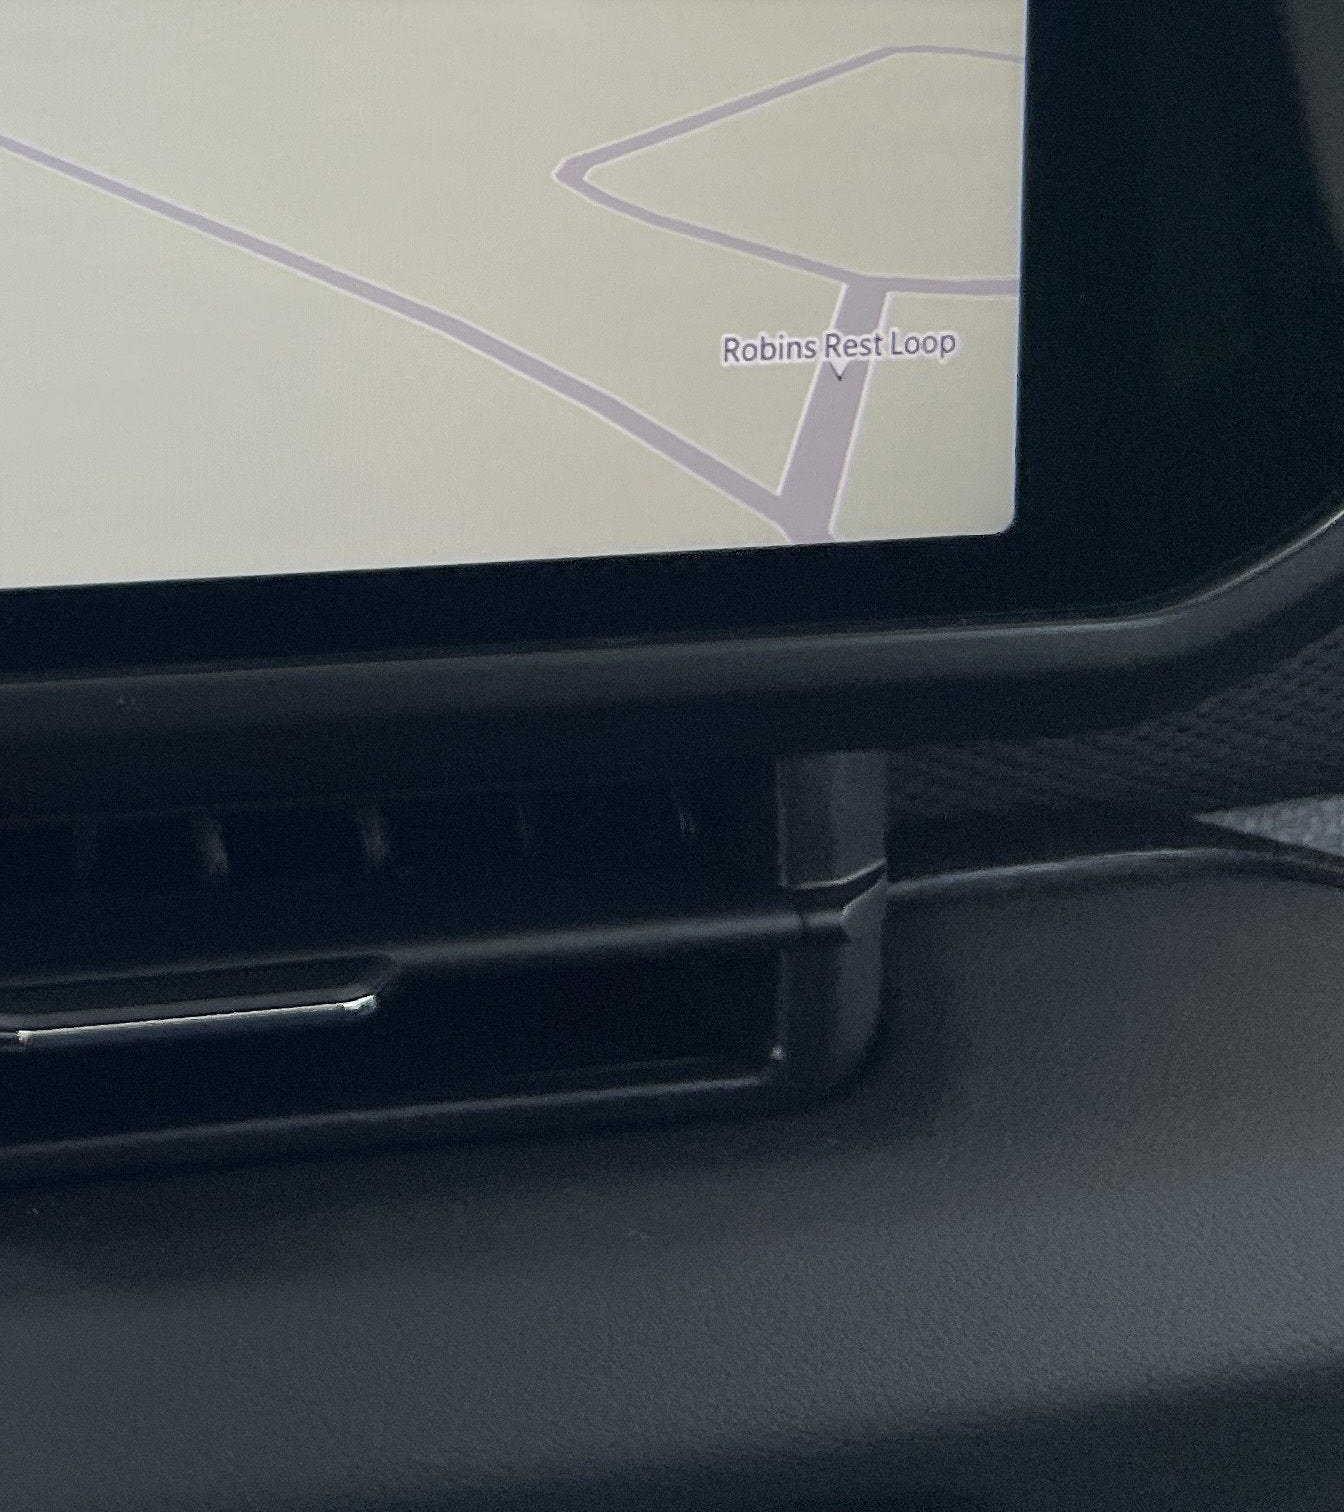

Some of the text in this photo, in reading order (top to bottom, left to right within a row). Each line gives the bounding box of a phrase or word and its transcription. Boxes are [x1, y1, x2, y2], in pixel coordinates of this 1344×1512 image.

[723, 330, 957, 362] Robins Rest Loop
